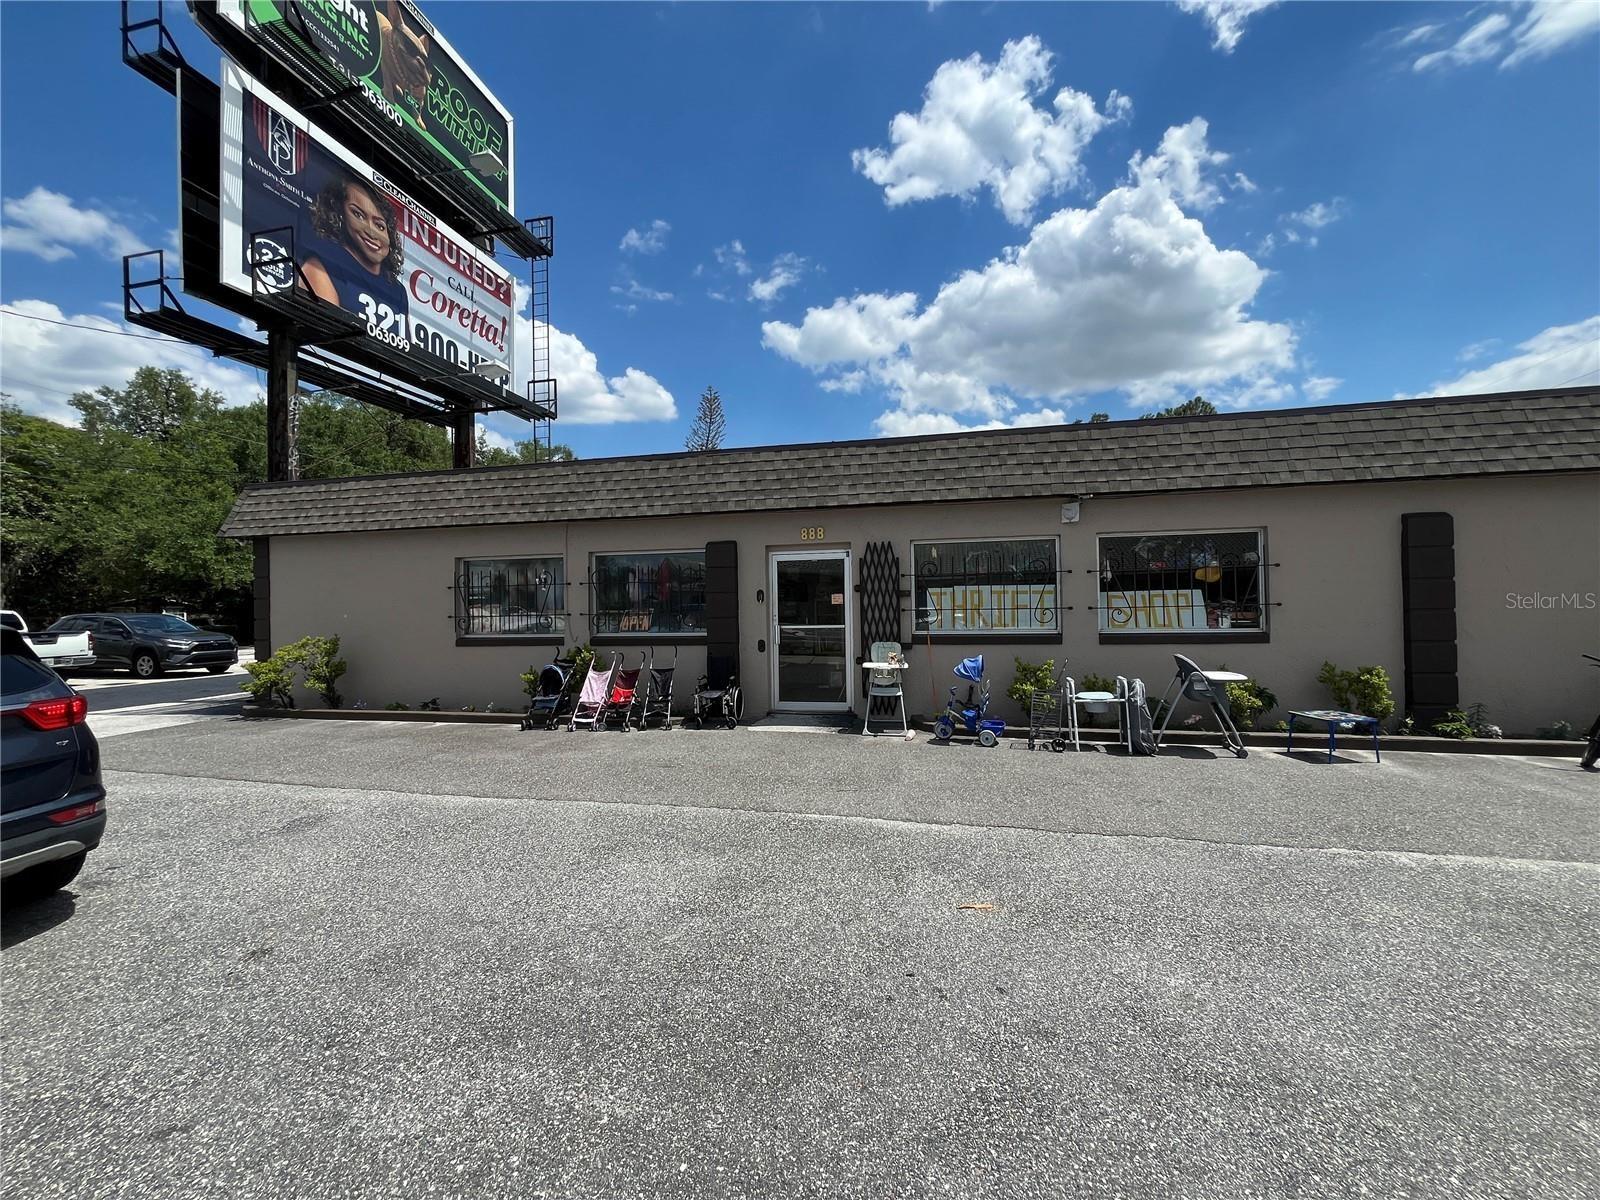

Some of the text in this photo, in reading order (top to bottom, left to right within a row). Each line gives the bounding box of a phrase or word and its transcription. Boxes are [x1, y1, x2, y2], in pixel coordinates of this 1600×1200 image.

[341, 15, 373, 56] INC.
[427, 87, 476, 154] WITH
[428, 64, 503, 153] ROOF
[403, 207, 508, 300] INJURED?
[447, 276, 476, 304] CALL
[409, 269, 507, 352] Coretta!
[366, 322, 410, 352] 063099
[801, 527, 824, 540] 888
[622, 615, 649, 631] OPEN
[930, 589, 1054, 629] THRIFT
[1109, 591, 1192, 629] SHOP
